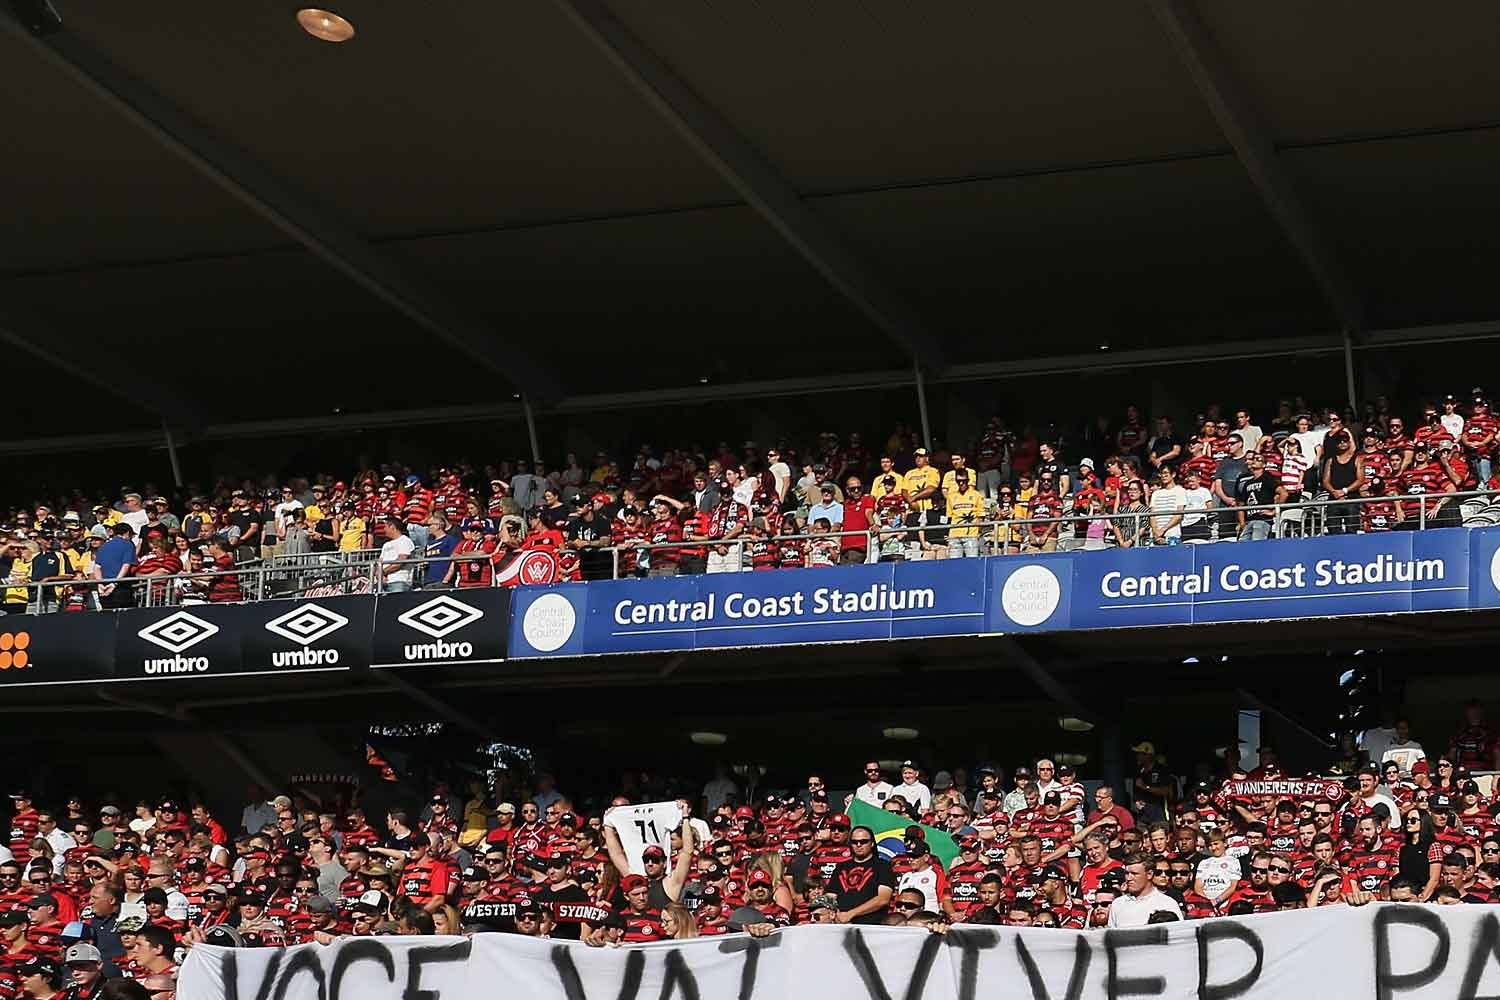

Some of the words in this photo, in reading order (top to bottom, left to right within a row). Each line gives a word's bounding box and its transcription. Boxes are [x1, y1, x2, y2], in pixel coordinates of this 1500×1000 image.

[1101, 565, 1210, 598] Central
[1219, 564, 1305, 593] Coast
[1314, 555, 1445, 587] Stadium
[613, 593, 715, 625] Central
[724, 592, 803, 619] Coast
[813, 583, 935, 614] Stadium
[272, 646, 339, 667] umbro
[404, 639, 473, 661] umbro
[144, 653, 209, 675] umbro
[1234, 781, 1304, 795] WANDERERS
[1305, 782, 1324, 795] FC
[634, 820, 661, 844] 71
[465, 903, 517, 917] WESTER
